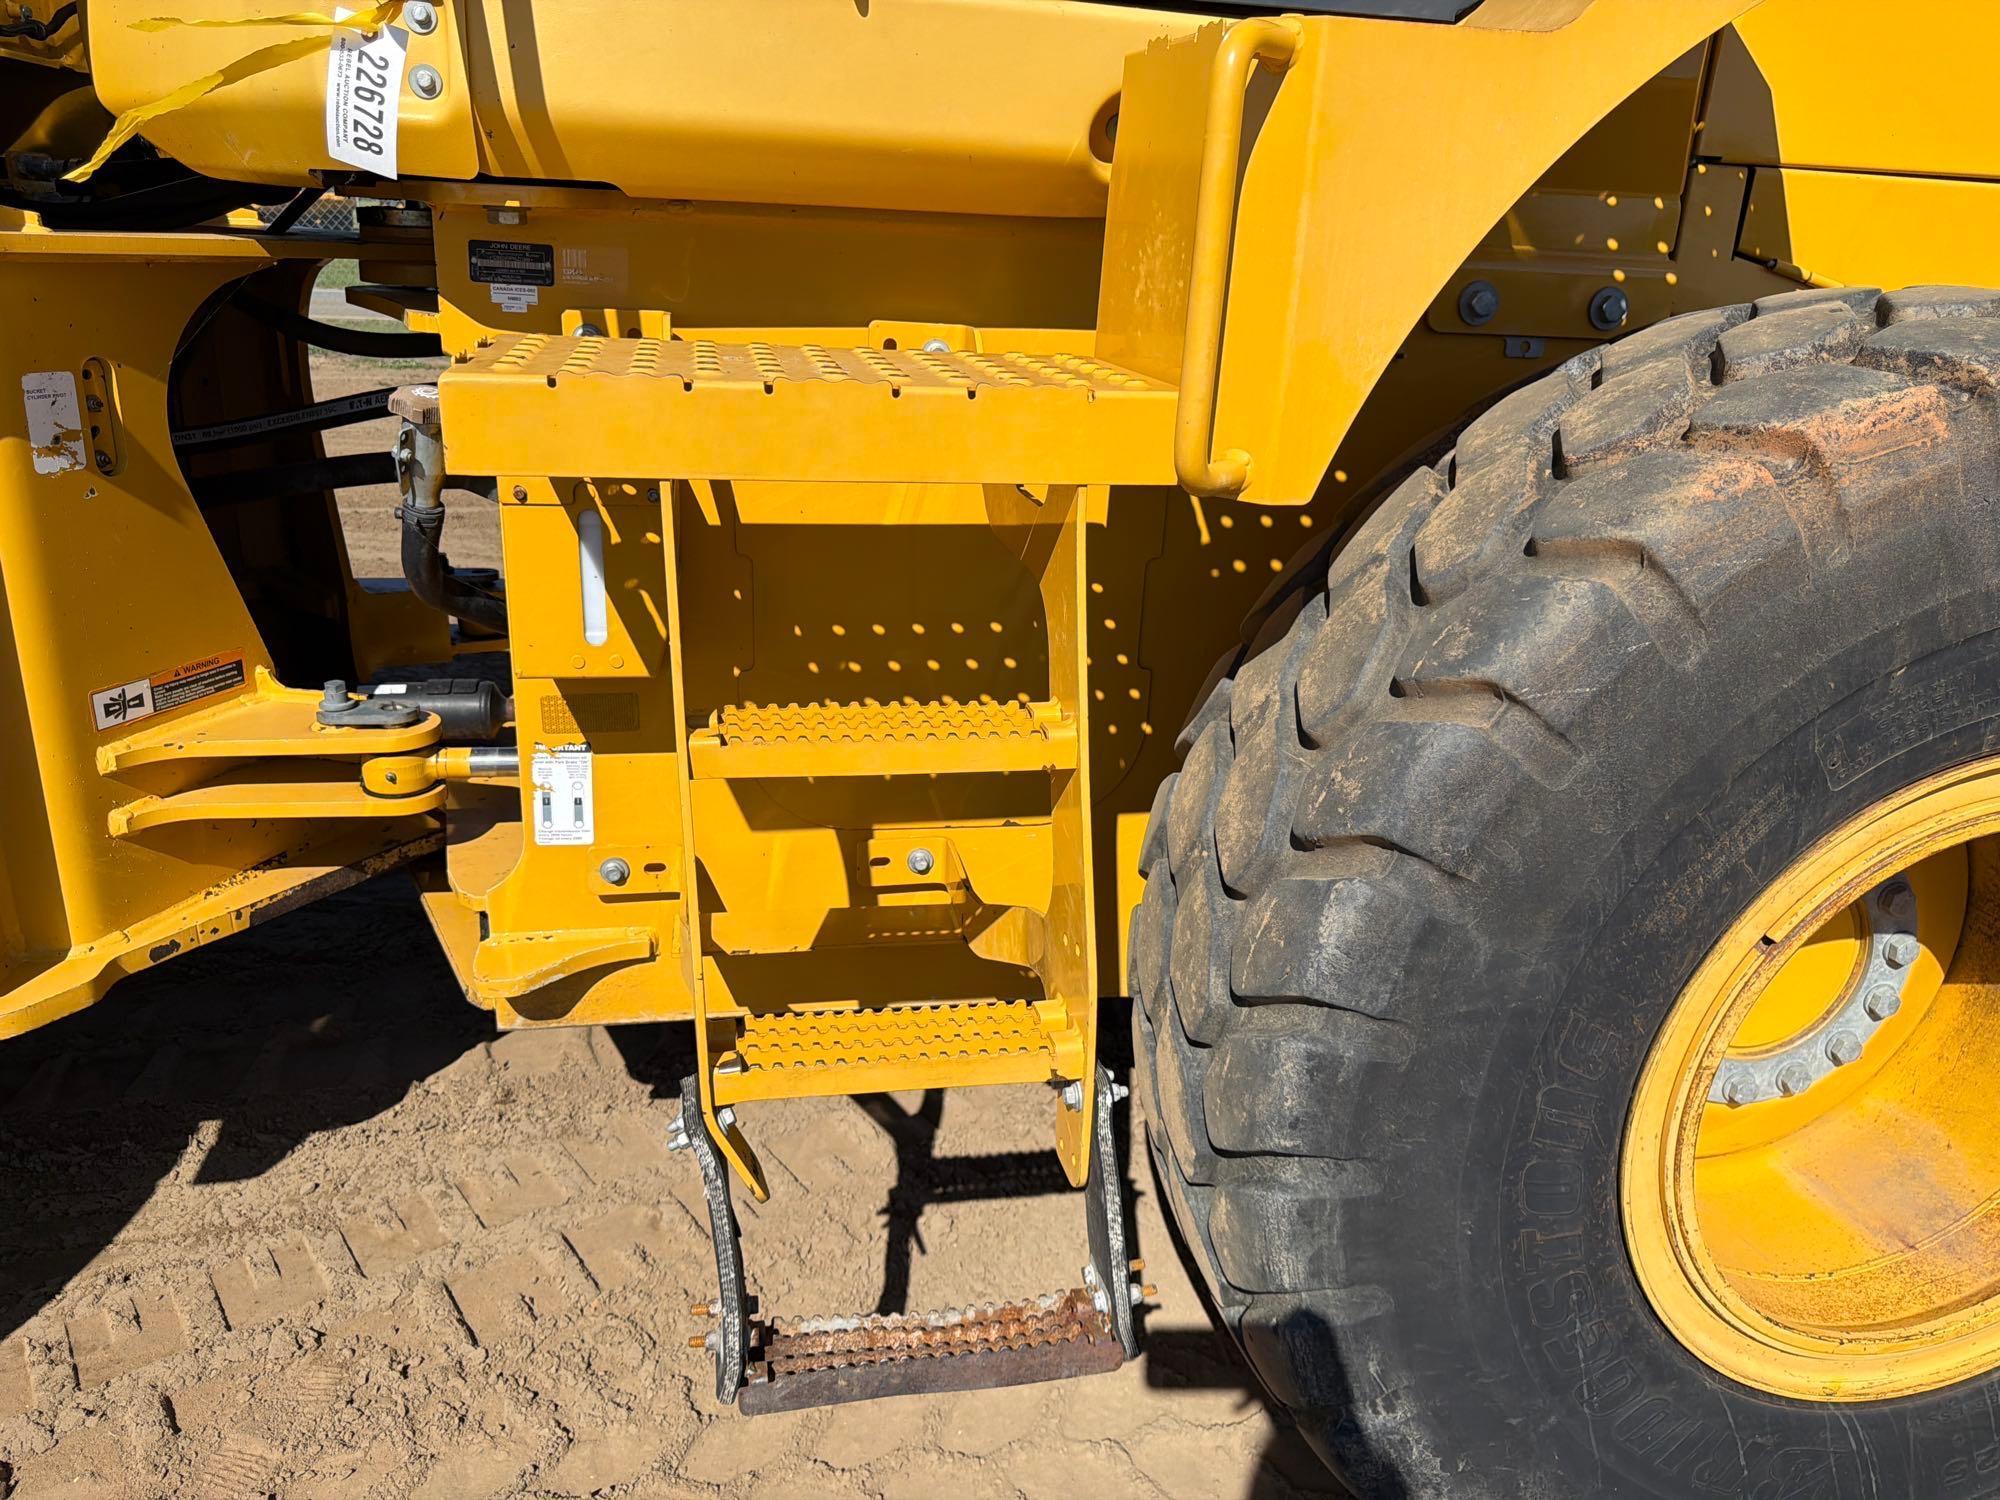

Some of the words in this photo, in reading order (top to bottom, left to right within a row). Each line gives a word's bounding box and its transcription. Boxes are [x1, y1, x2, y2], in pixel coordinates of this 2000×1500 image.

[345, 48, 353, 72] REBEL
[352, 49, 390, 156] 226728
[490, 242, 508, 250] JOHN
[510, 243, 531, 251] DEERE
[182, 658, 220, 674] WARNING
